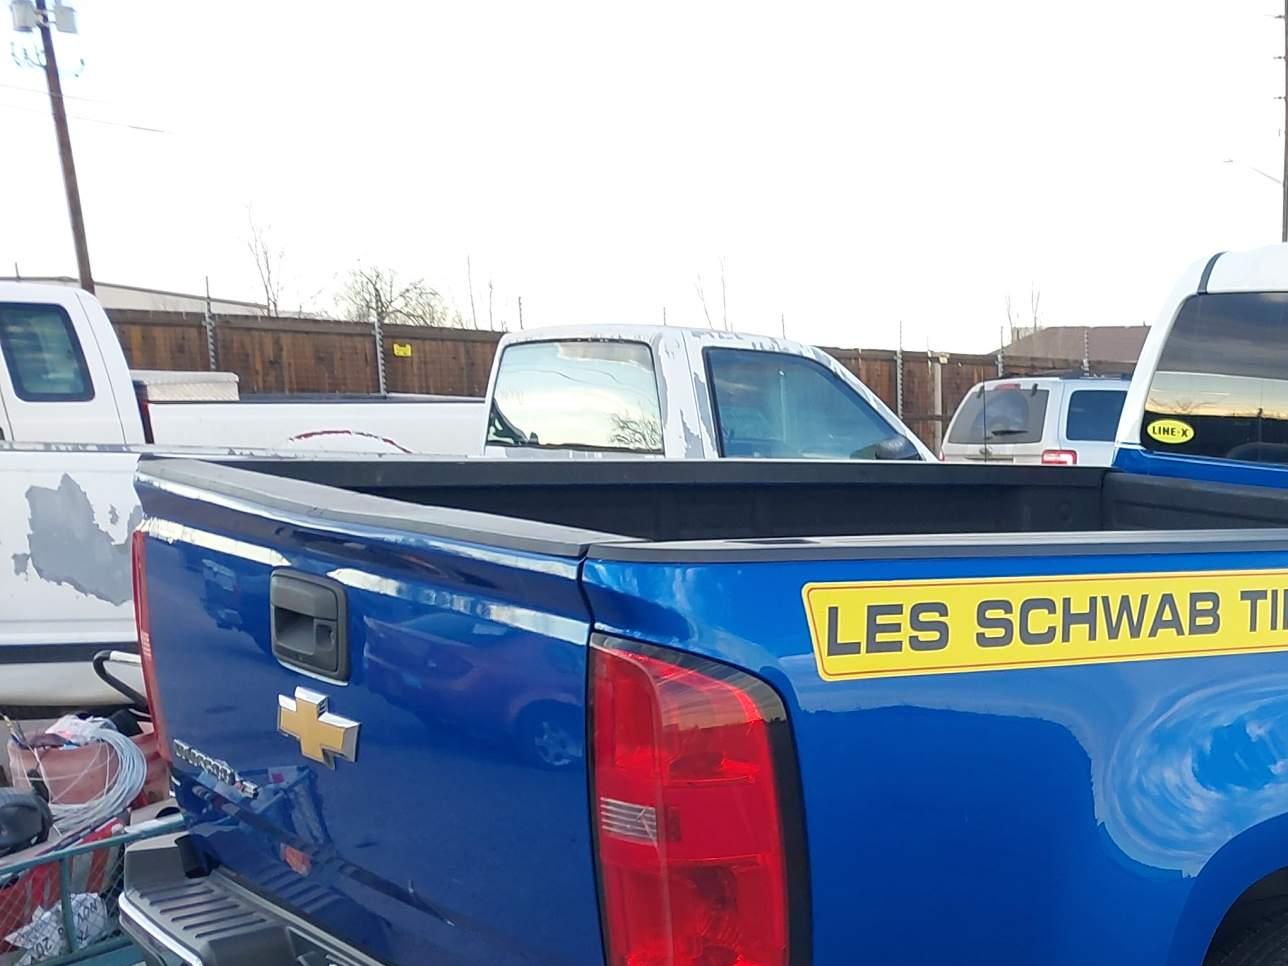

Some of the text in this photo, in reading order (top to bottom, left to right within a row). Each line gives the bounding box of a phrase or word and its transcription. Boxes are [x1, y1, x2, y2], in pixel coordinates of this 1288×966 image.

[1152, 425, 1189, 438] LINE-X
[826, 602, 950, 657] LES
[974, 590, 1221, 647] SCHWAB
